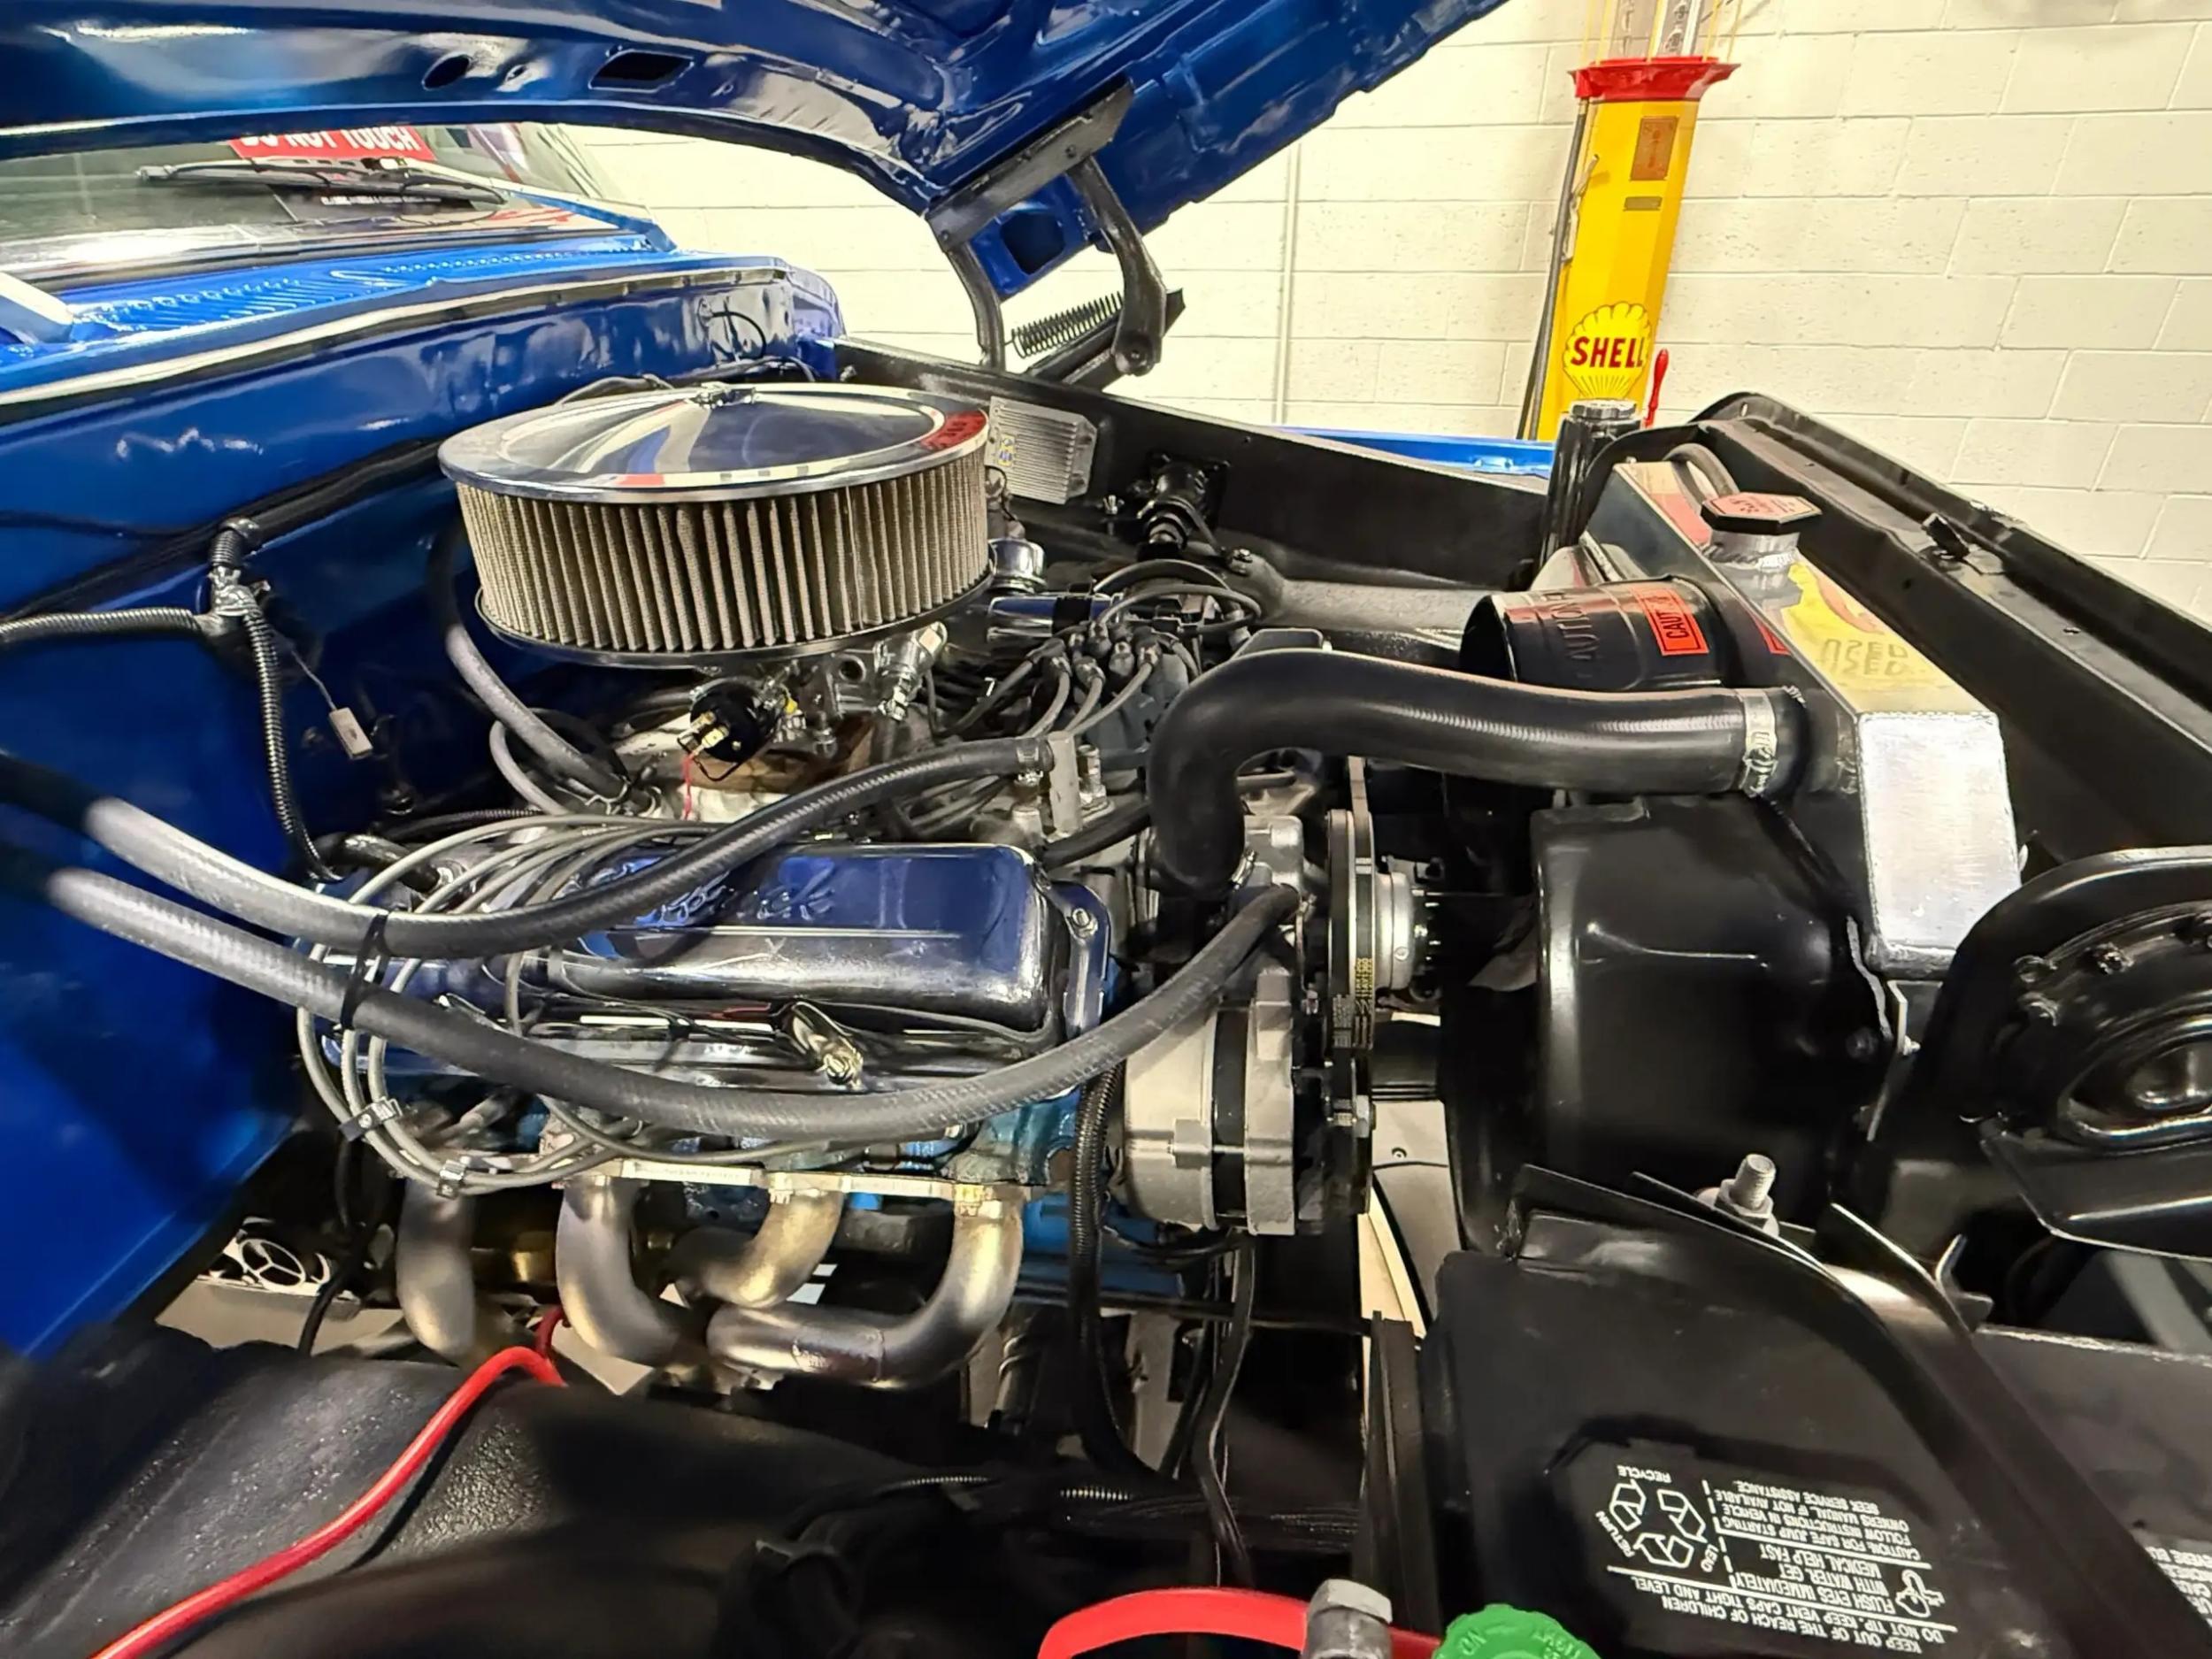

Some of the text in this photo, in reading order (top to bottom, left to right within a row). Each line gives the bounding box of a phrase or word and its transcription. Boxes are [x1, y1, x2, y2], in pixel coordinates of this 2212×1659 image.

[341, 126, 422, 151] TOUCH
[1571, 336, 1645, 368] SHELL
[1617, 1465, 1671, 1483] RECYCLE
[1714, 1489, 1768, 1509] AVAILABLE
[1772, 1500, 1795, 1514] NOT
[1802, 1492, 1849, 1510] SERVICE
[1849, 1500, 1880, 1515] SEEK
[1798, 1505, 1809, 1517] IF
[1722, 1517, 1776, 1536] STARTING
[1723, 1503, 1912, 1547] FOLLOW INSTRUCTIONS IN VEHICLE
[1860, 1515, 1909, 1532] OWNERS
[1595, 1510, 1635, 1557] RETURN
[1779, 1527, 1808, 1542] JUMP
[1809, 1532, 1840, 1548] SAFE
[1841, 1538, 1867, 1552] FOR
[1759, 1543, 1882, 1578] MEDICAL HELP FAST
[1778, 1563, 1804, 1582] GET
[1631, 1576, 1671, 1595] LEVEL
[1674, 1585, 1700, 1601] AND
[1734, 1572, 1896, 1615] FLUSH EYES IMMEDIATELY
[1853, 1576, 1889, 1597] WITH
[1705, 1591, 1744, 1609] TIGHT
[1746, 1597, 1782, 1616] CAPS
[1786, 1606, 1820, 1623] VENT
[1823, 1612, 1858, 1629] KEEP
[1661, 1595, 1922, 1654] KEEP OUT OF THE REACH OF CHILDREN
[1890, 1623, 1920, 1640] NOT
[1922, 1627, 1946, 1644] DO
